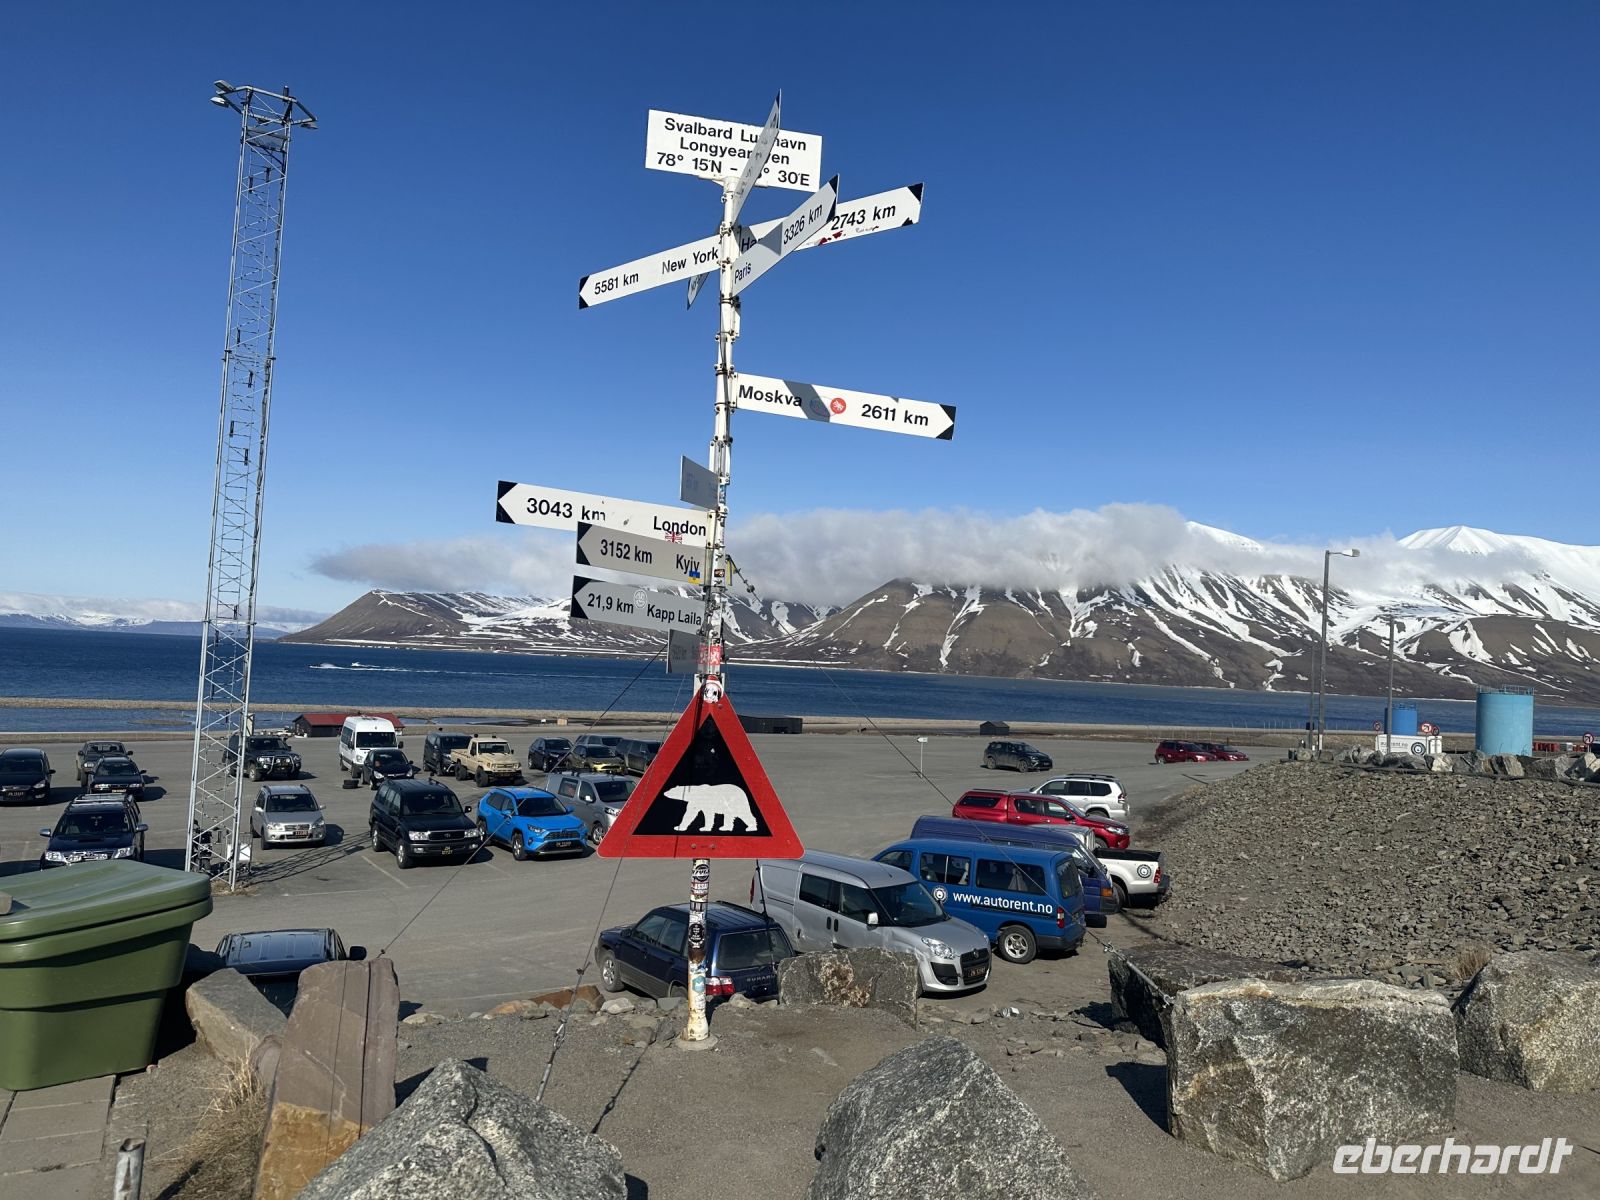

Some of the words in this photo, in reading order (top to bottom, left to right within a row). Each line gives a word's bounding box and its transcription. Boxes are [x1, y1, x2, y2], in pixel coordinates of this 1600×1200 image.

[664, 117, 733, 140] Svalbard
[656, 151, 684, 167] 78°
[831, 209, 866, 231] 2743
[873, 204, 896, 221] km
[734, 261, 752, 285] Paris
[783, 215, 806, 245] 3326
[808, 203, 823, 224] km
[594, 276, 619, 295] 5581
[623, 272, 639, 287] km
[661, 258, 687, 275] New
[692, 247, 719, 265] York
[738, 384, 802, 408] Moskva
[861, 403, 897, 422] 2611
[904, 409, 929, 427] km
[526, 497, 573, 519] 3043
[581, 505, 606, 522] km
[653, 515, 707, 537] London
[600, 538, 631, 561] 3152
[634, 545, 653, 565] km
[675, 553, 700, 575] Kyiv
[587, 592, 613, 612] 21,9
[616, 598, 634, 614] km
[646, 603, 675, 624] Kapp
[677, 609, 702, 626] Laila
[952, 892, 1053, 914] www.autorent.no
